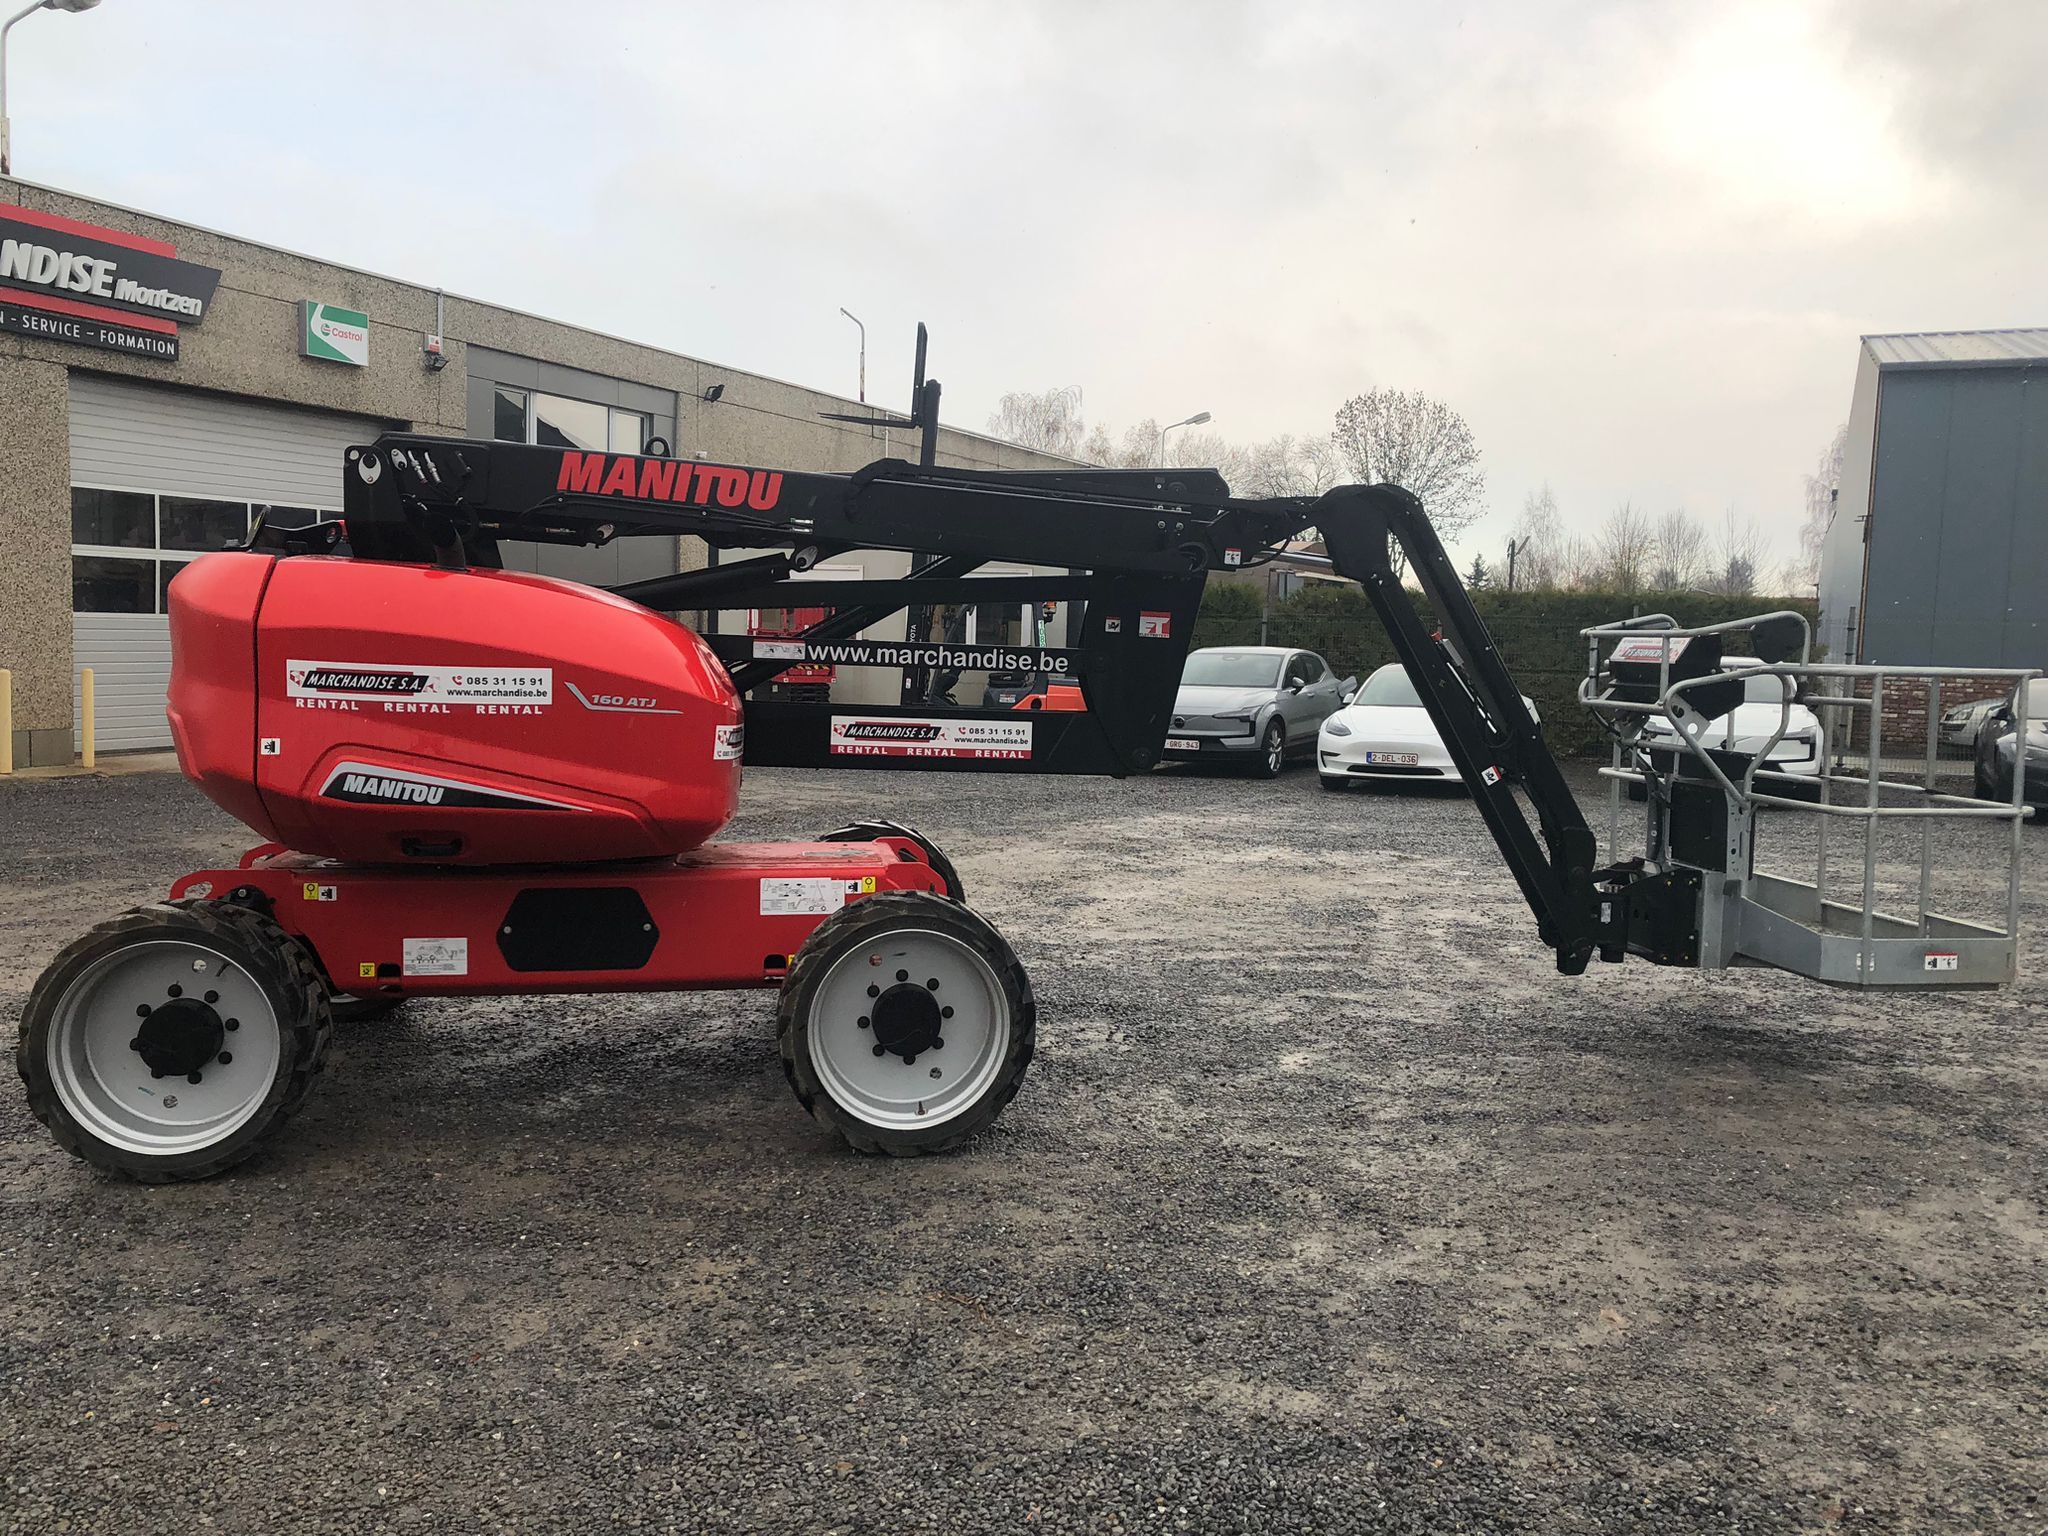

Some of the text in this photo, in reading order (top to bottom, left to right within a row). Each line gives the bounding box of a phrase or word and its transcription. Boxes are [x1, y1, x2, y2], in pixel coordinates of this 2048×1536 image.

[114, 278, 202, 316] Montzen
[22, 315, 81, 338] SERVICE
[100, 330, 175, 355] FORMATION
[332, 327, 363, 342] Castrol
[556, 451, 783, 511] MANITOU
[807, 645, 1069, 673] www.marchandise.be
[306, 673, 421, 690] MARCHANDISE S.A.
[466, 676, 543, 686] 085 31 15 91
[447, 688, 548, 698] www.marchandise.be
[295, 698, 543, 715] RENTAL RENTAL RENTAL
[591, 694, 657, 708] 160 ATJ
[847, 726, 936, 739] MARCHANDISE S.A.
[969, 727, 985, 735] 085
[954, 737, 1029, 745] www.marchandise.be
[837, 745, 1025, 759] RENTAL RENTAL RENTAL
[342, 774, 445, 805] MANITOU
